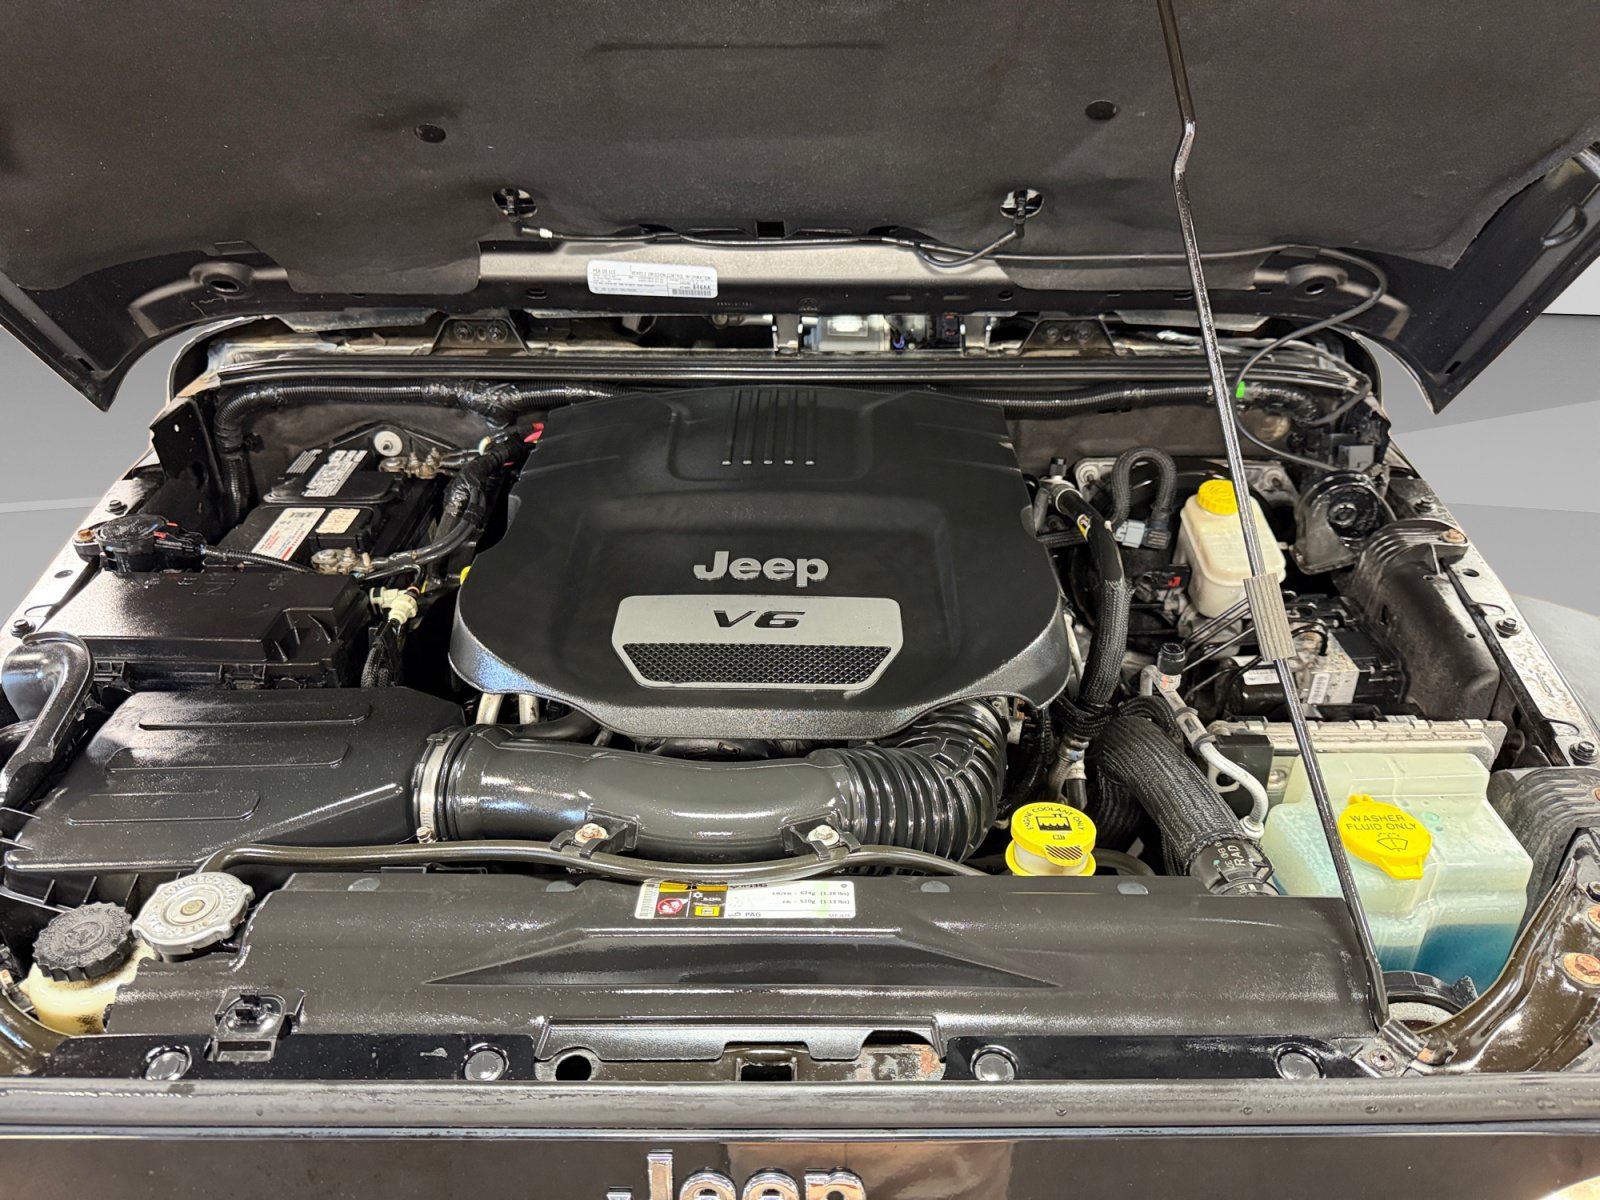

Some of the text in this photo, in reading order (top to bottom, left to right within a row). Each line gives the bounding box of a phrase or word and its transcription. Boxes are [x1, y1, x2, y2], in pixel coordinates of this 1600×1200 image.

[693, 550, 829, 588] Jeep
[713, 610, 806, 629] V6
[1032, 806, 1074, 816] COOLANT
[1072, 816, 1085, 831] ONLY
[1345, 822, 1417, 831] FLUID ONLY
[1349, 814, 1406, 822] WASHER
[1227, 845, 1246, 867] RAD
